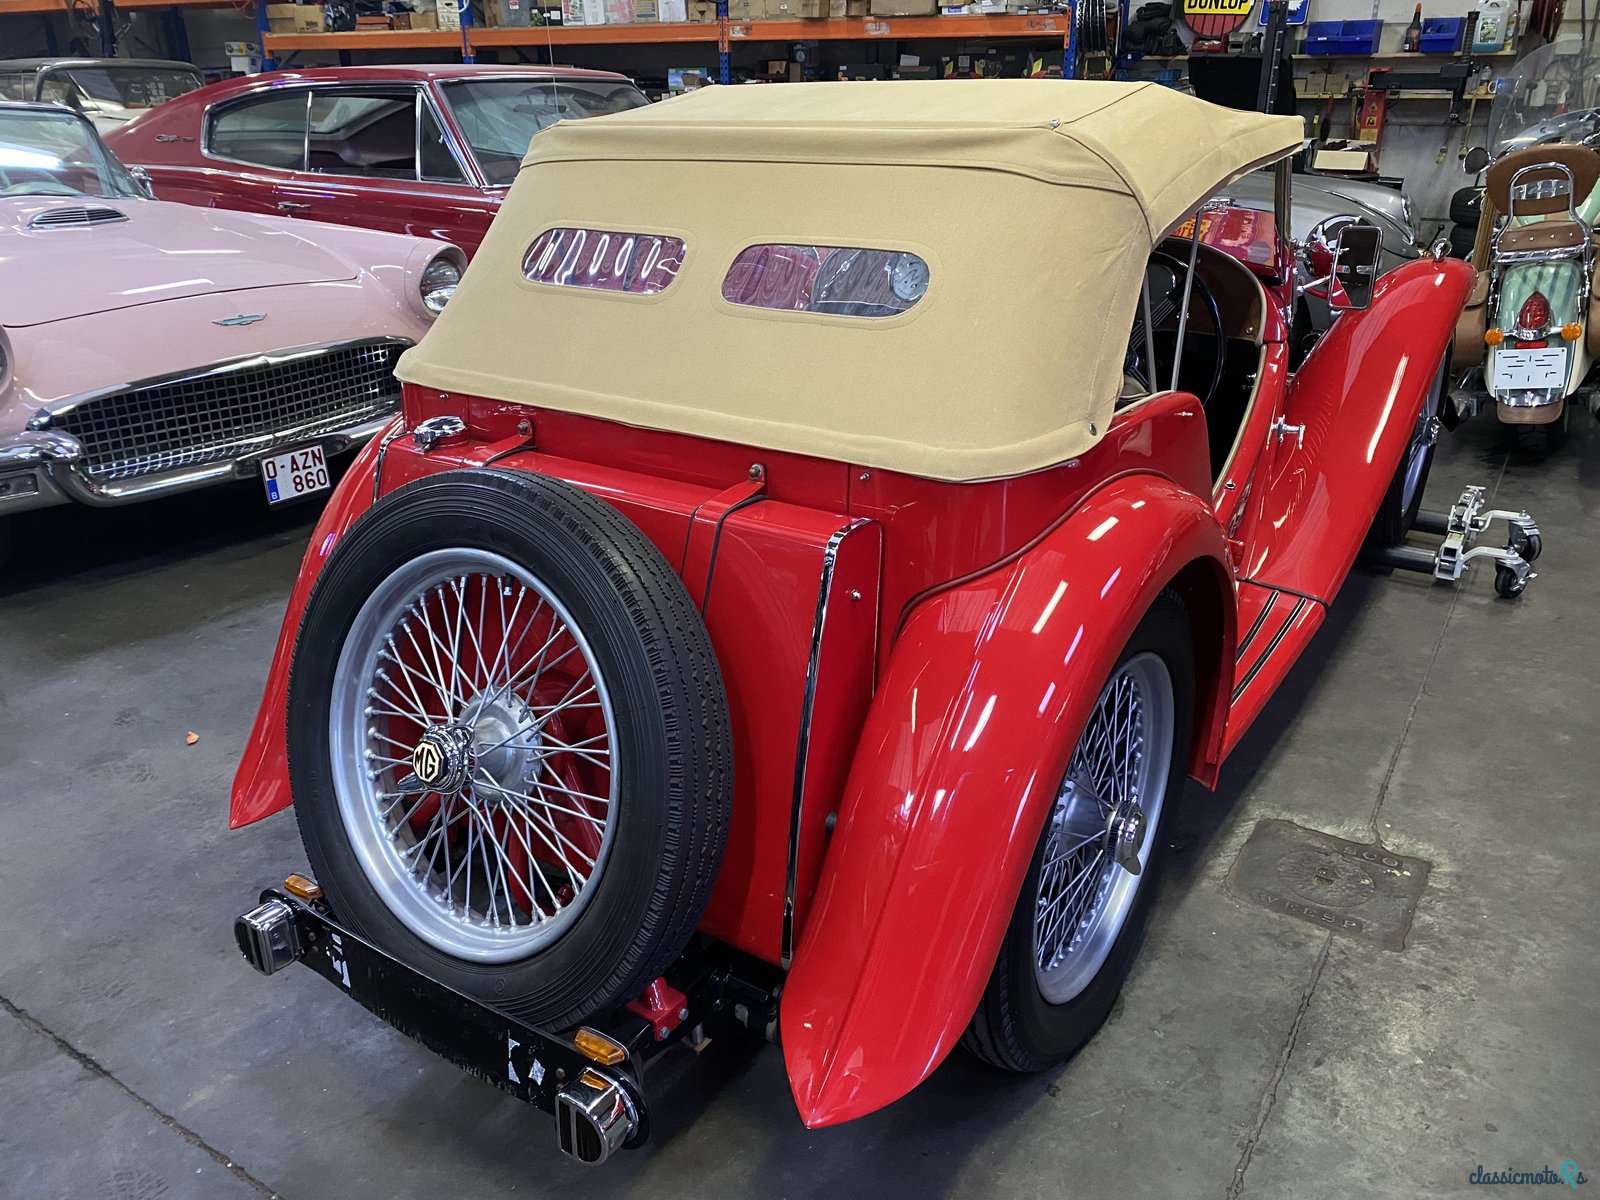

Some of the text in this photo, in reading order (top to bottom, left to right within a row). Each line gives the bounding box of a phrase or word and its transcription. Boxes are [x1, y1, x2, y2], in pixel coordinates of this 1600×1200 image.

[293, 468, 327, 492] 860
[271, 492, 278, 500] B
[414, 746, 436, 780] MG
